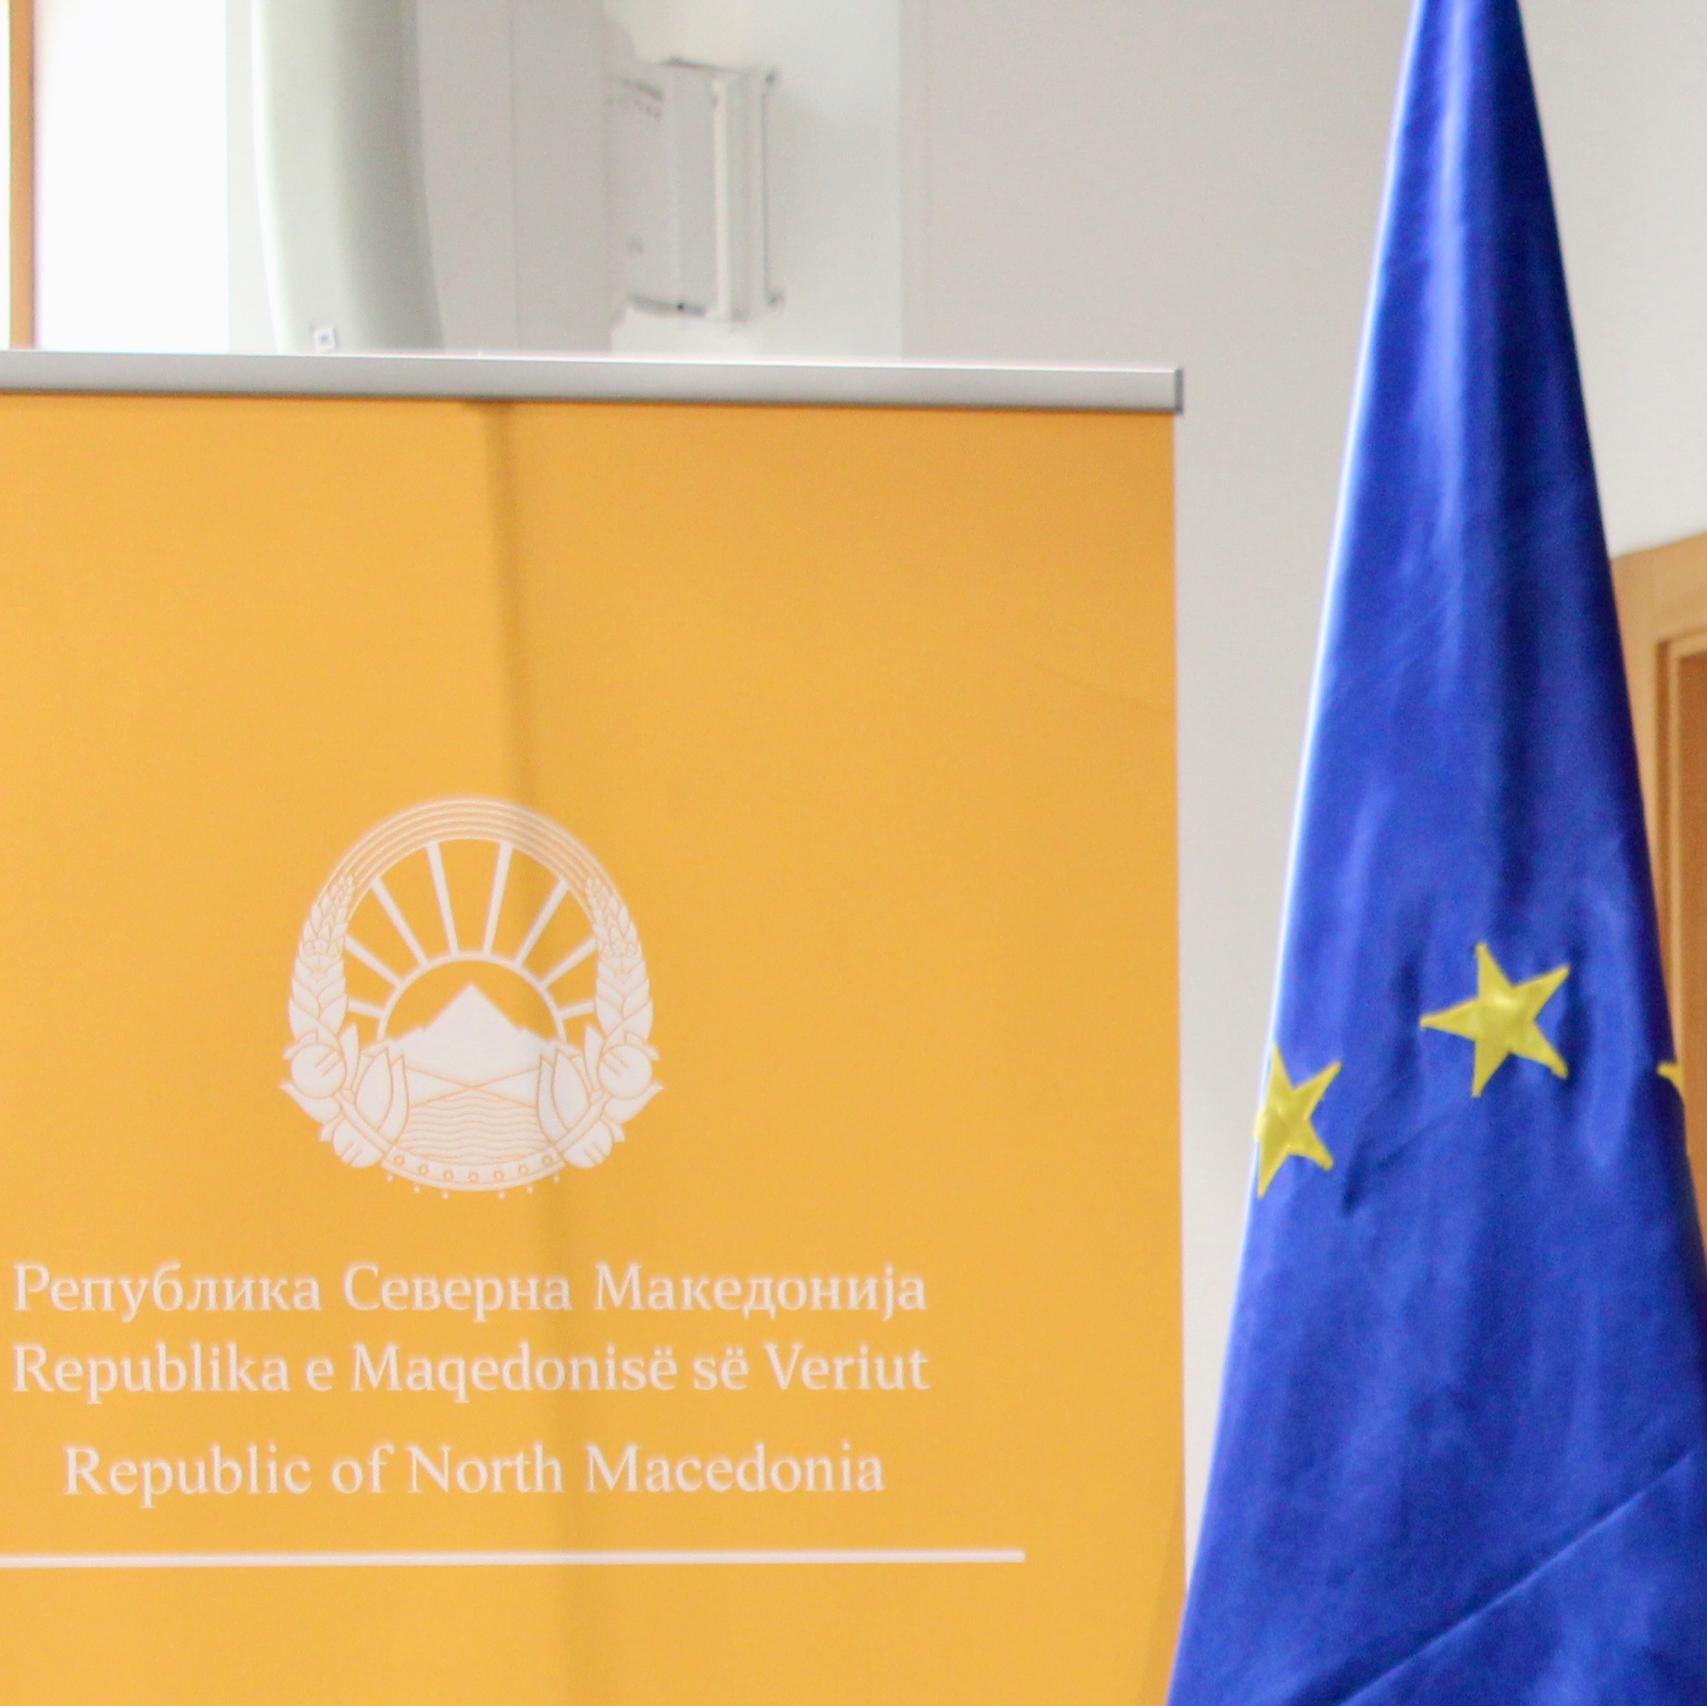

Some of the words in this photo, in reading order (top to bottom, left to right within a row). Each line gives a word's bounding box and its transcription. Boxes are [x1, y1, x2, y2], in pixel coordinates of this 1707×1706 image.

[13, 1261, 321, 1323] Република
[342, 1262, 571, 1323] Северна
[595, 1262, 927, 1321] Македонија
[13, 1341, 289, 1405] Republika
[304, 1358, 335, 1392] e
[351, 1340, 678, 1404] Maqedonisë
[692, 1347, 750, 1391] së
[763, 1342, 929, 1391] Veriut
[64, 1443, 310, 1509] Republic
[330, 1443, 391, 1494] of
[405, 1441, 562, 1493] North
[586, 1440, 884, 1493] Macedonia
